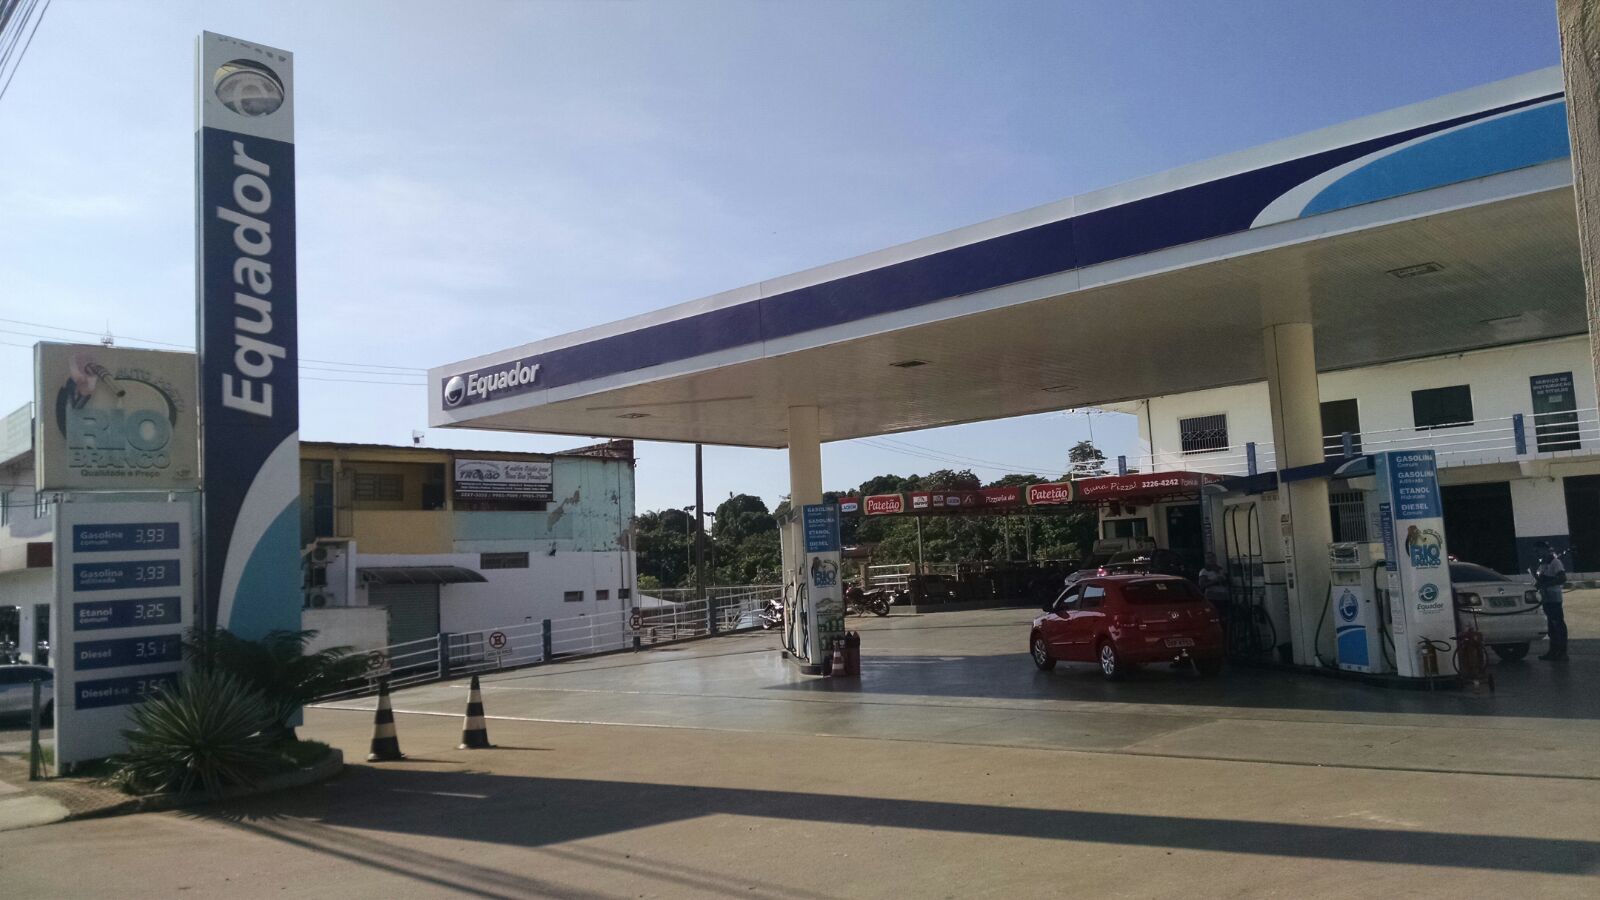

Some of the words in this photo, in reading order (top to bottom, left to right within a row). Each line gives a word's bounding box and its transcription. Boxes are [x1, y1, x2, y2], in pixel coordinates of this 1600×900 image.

[217, 140, 286, 417] Equador
[467, 362, 540, 398] Equador
[66, 408, 173, 451] RIO
[1396, 454, 1433, 463] GASOLINA
[1398, 470, 1434, 479] GASOLINA
[1031, 487, 1068, 500] Patetão
[1400, 487, 1430, 495] ETANOL
[867, 499, 900, 511] Patetão
[1401, 503, 1429, 511] DIESEL
[80, 530, 124, 540] Gasolina
[135, 528, 165, 543] 3,93
[80, 568, 124, 578] Gasolina
[135, 565, 165, 582] 3,93
[80, 608, 112, 618] Etanol
[135, 603, 165, 620] 3,25
[1416, 602, 1443, 611] Equador
[80, 648, 112, 660] Diesel
[81, 687, 113, 699] Diesel
